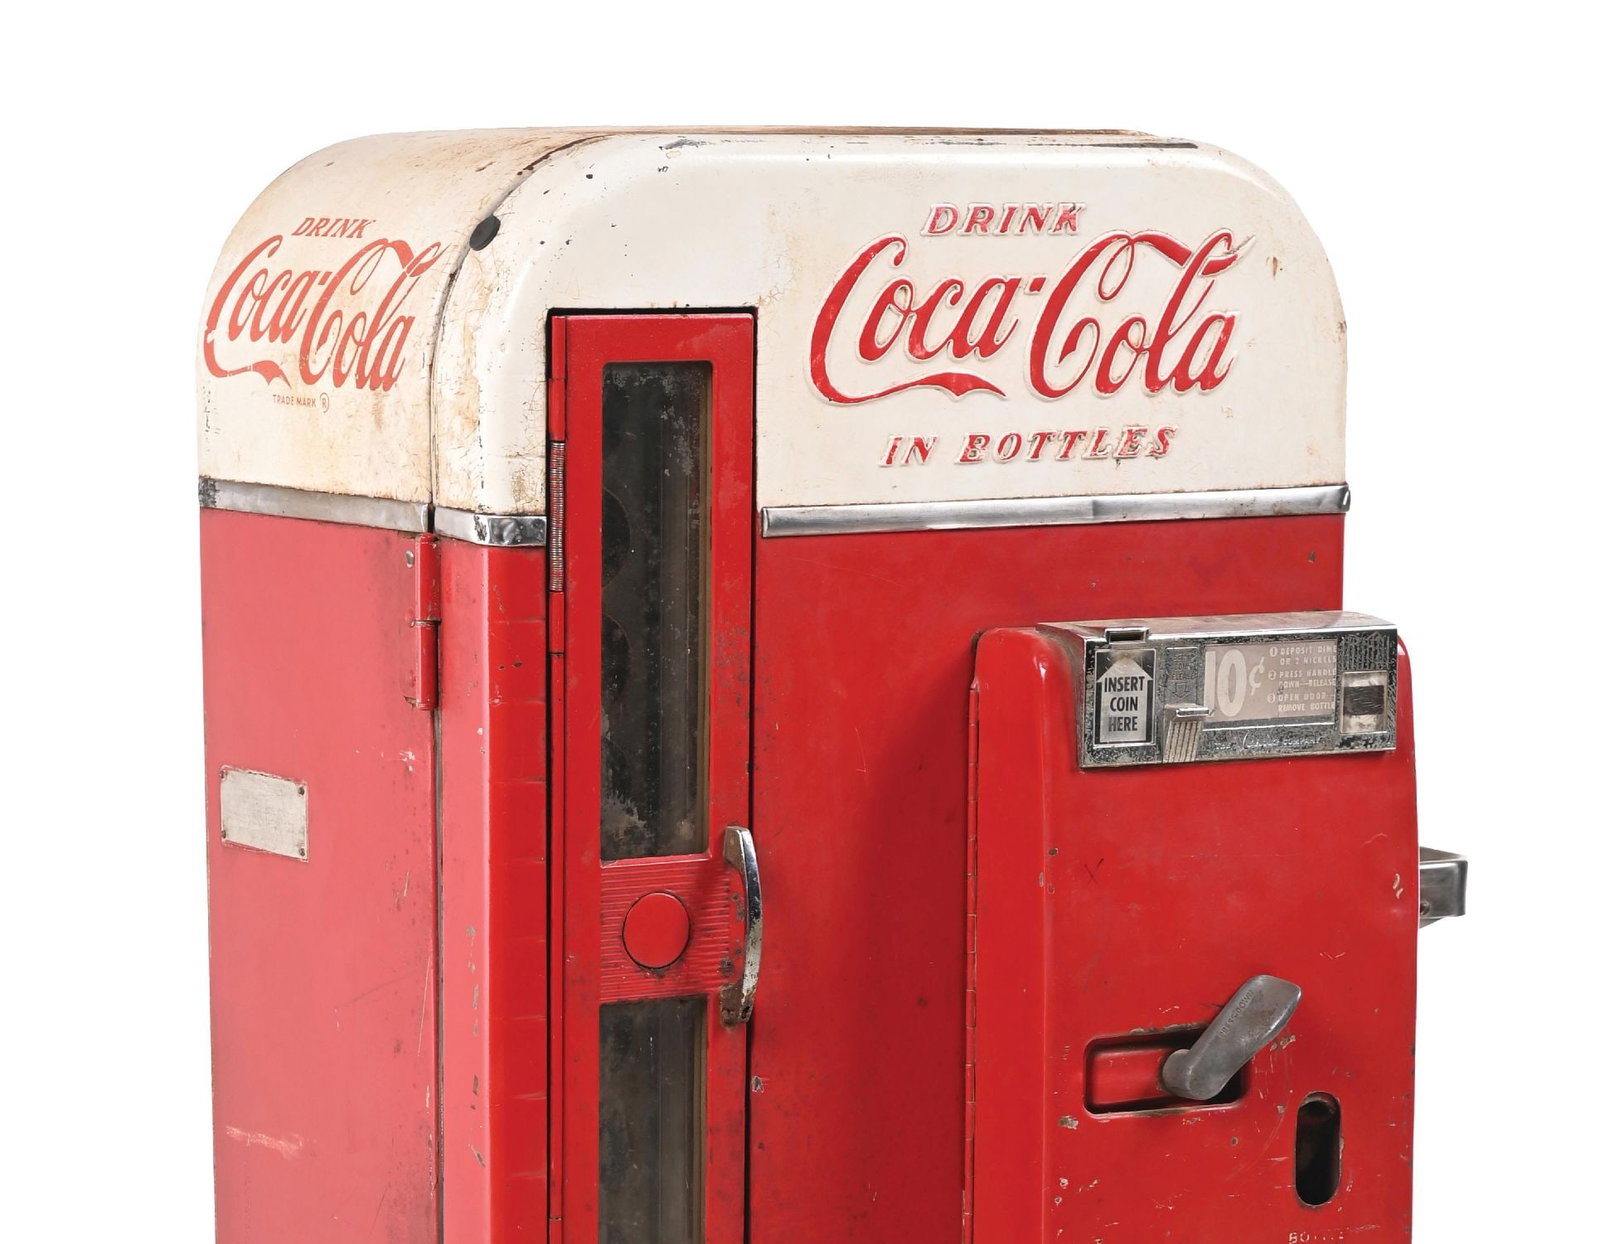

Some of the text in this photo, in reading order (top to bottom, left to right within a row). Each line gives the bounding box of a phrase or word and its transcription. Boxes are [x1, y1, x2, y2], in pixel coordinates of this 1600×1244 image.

[921, 202, 1085, 236] DRINK
[291, 217, 376, 239] DRINK
[203, 234, 449, 392] Coca-Cola
[806, 228, 1257, 405] Coca-Cola
[272, 394, 295, 406] TRADE
[296, 396, 317, 408] MARK
[879, 424, 1179, 467] IN BOTTLES
[1280, 646, 1313, 655] DEPOSIT
[1317, 645, 1337, 653] DIME
[1303, 655, 1337, 664] NICKELS
[1279, 670, 1303, 678] PRESS
[1306, 668, 1336, 677] HANDLE
[1104, 676, 1145, 692] INSERT
[1110, 696, 1138, 712] COIN
[1278, 693, 1299, 702] OPEN
[1278, 701, 1336, 712] REMOVE BOTTLE
[1108, 716, 1138, 732] HERE
